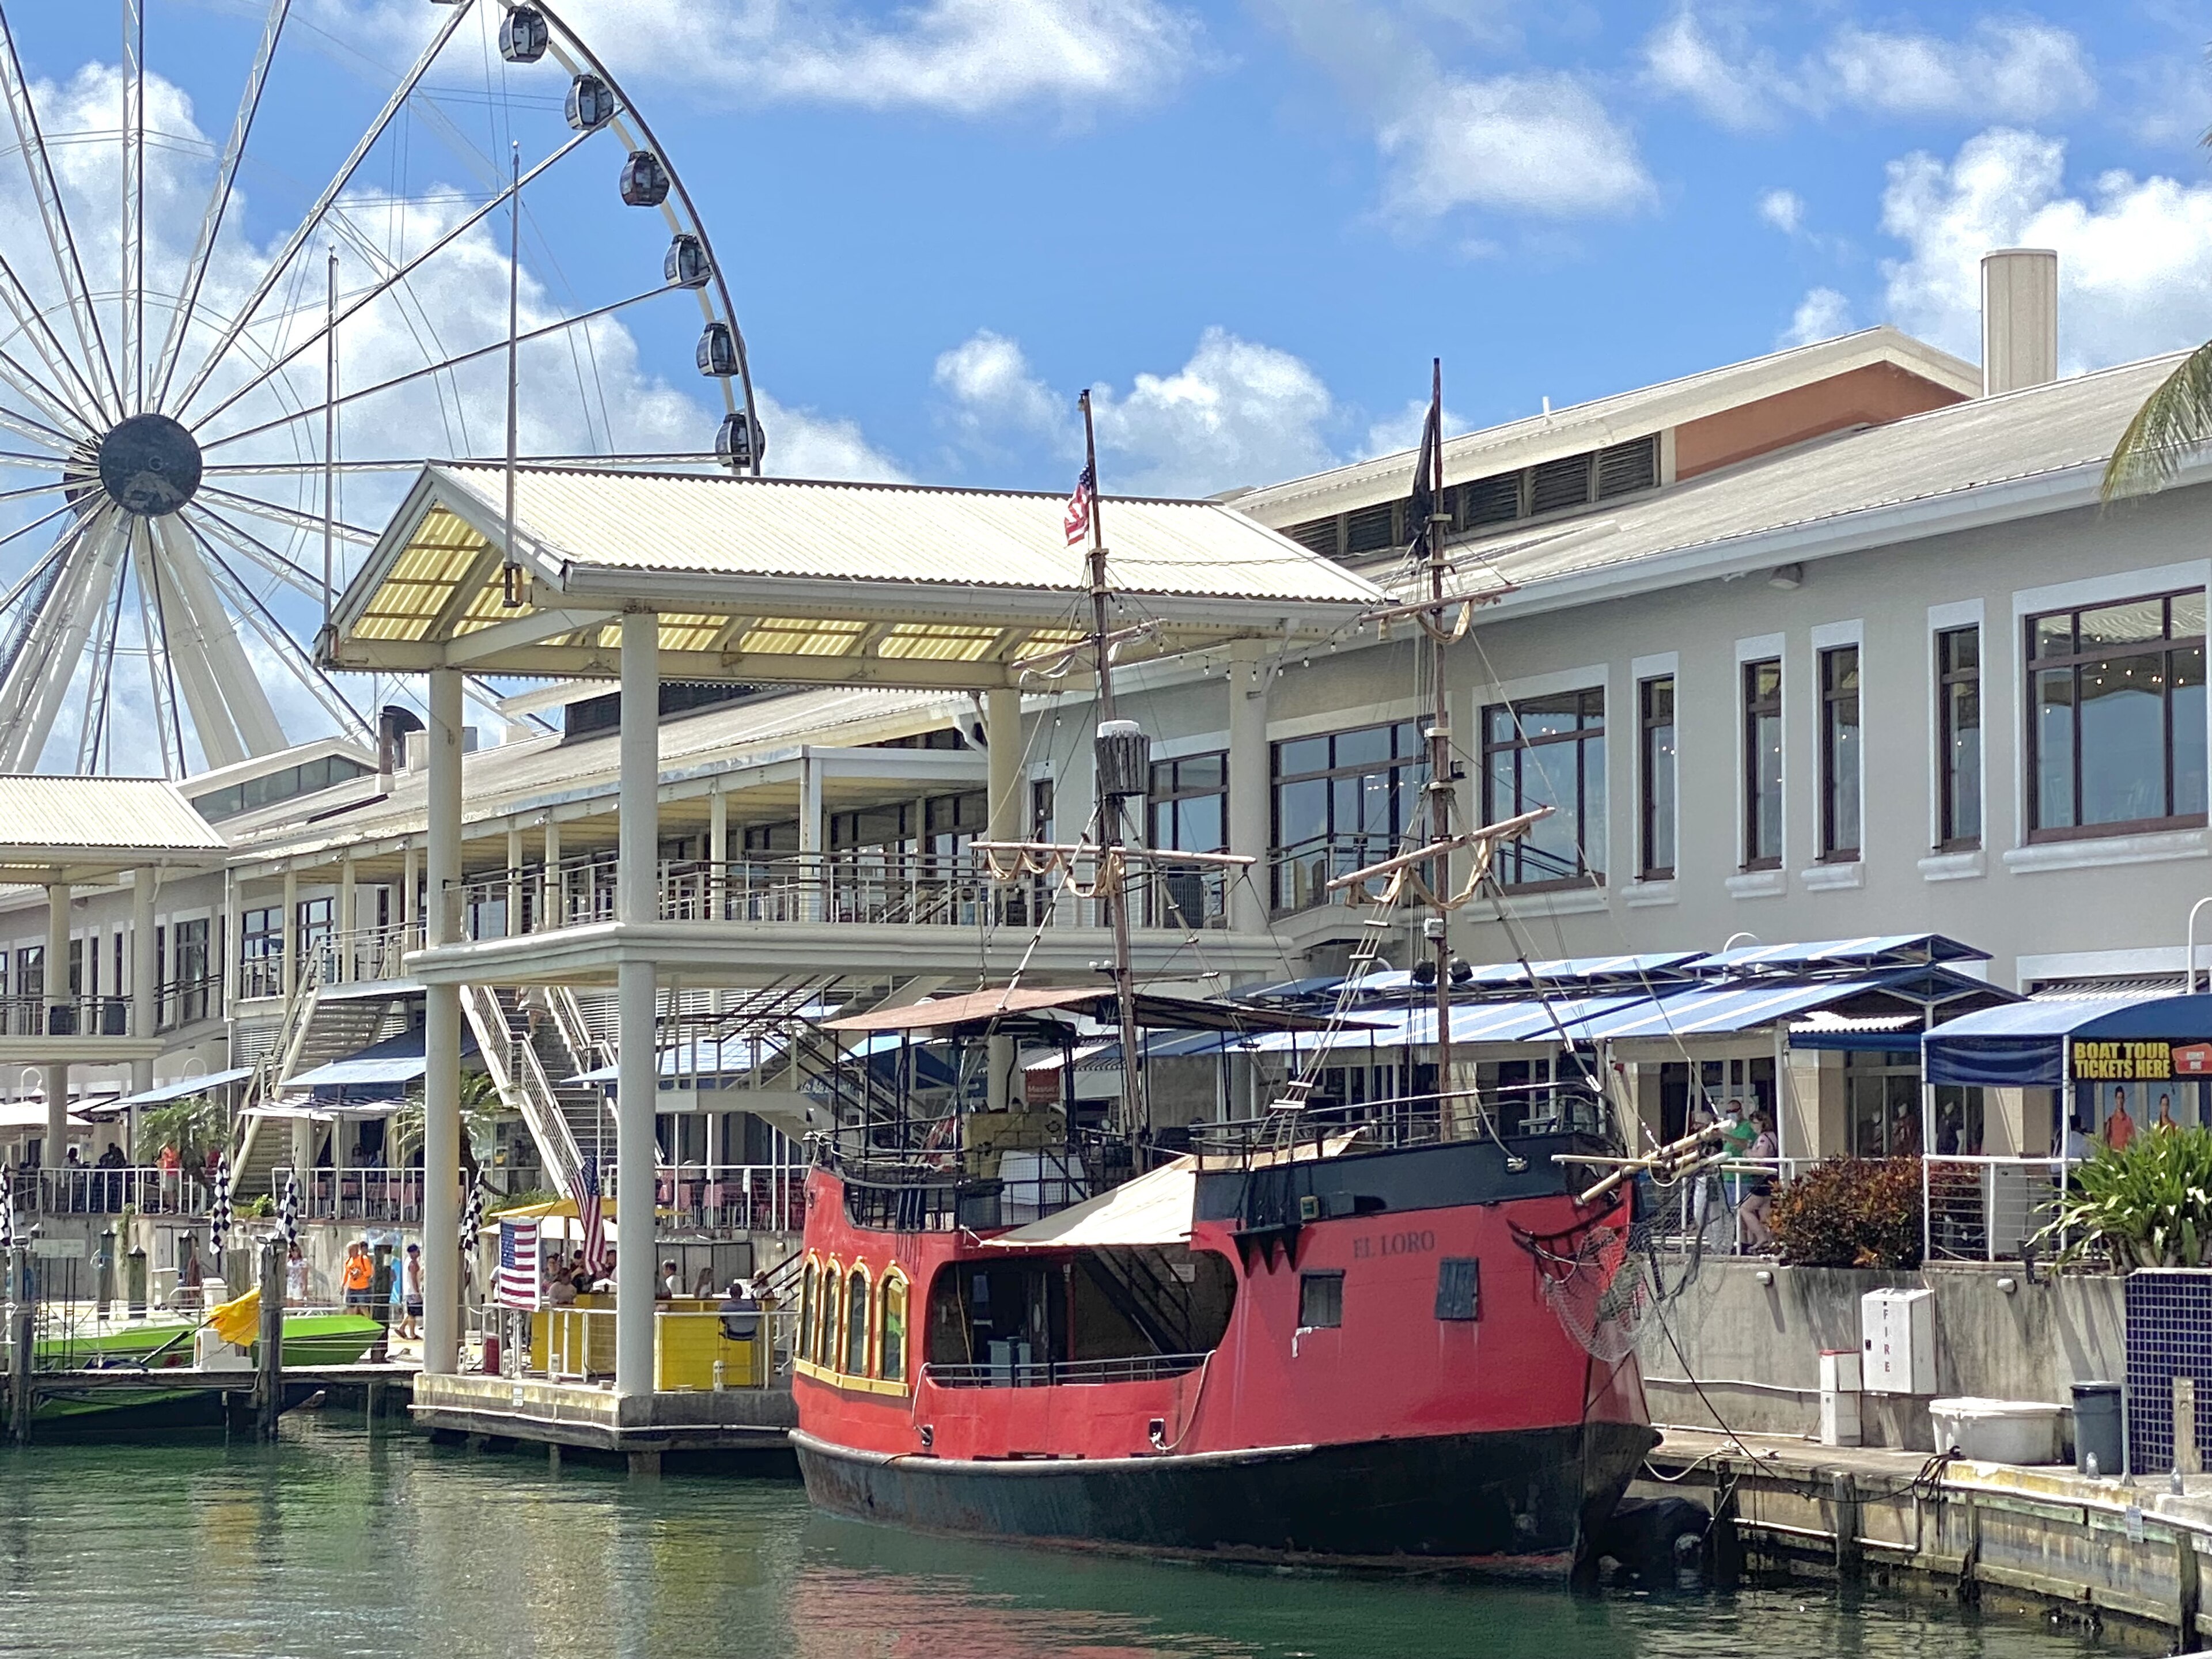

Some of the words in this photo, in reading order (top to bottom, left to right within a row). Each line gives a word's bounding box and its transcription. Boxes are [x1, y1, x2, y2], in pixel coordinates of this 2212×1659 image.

[2074, 1042, 2121, 1059] BOAT
[2123, 1042, 2170, 1059] TOUR
[2075, 1059, 2133, 1078] TICKETS
[2135, 1059, 2171, 1078] HERE
[1354, 1237, 1376, 1258] EL
[1381, 1230, 1434, 1256] LORO
